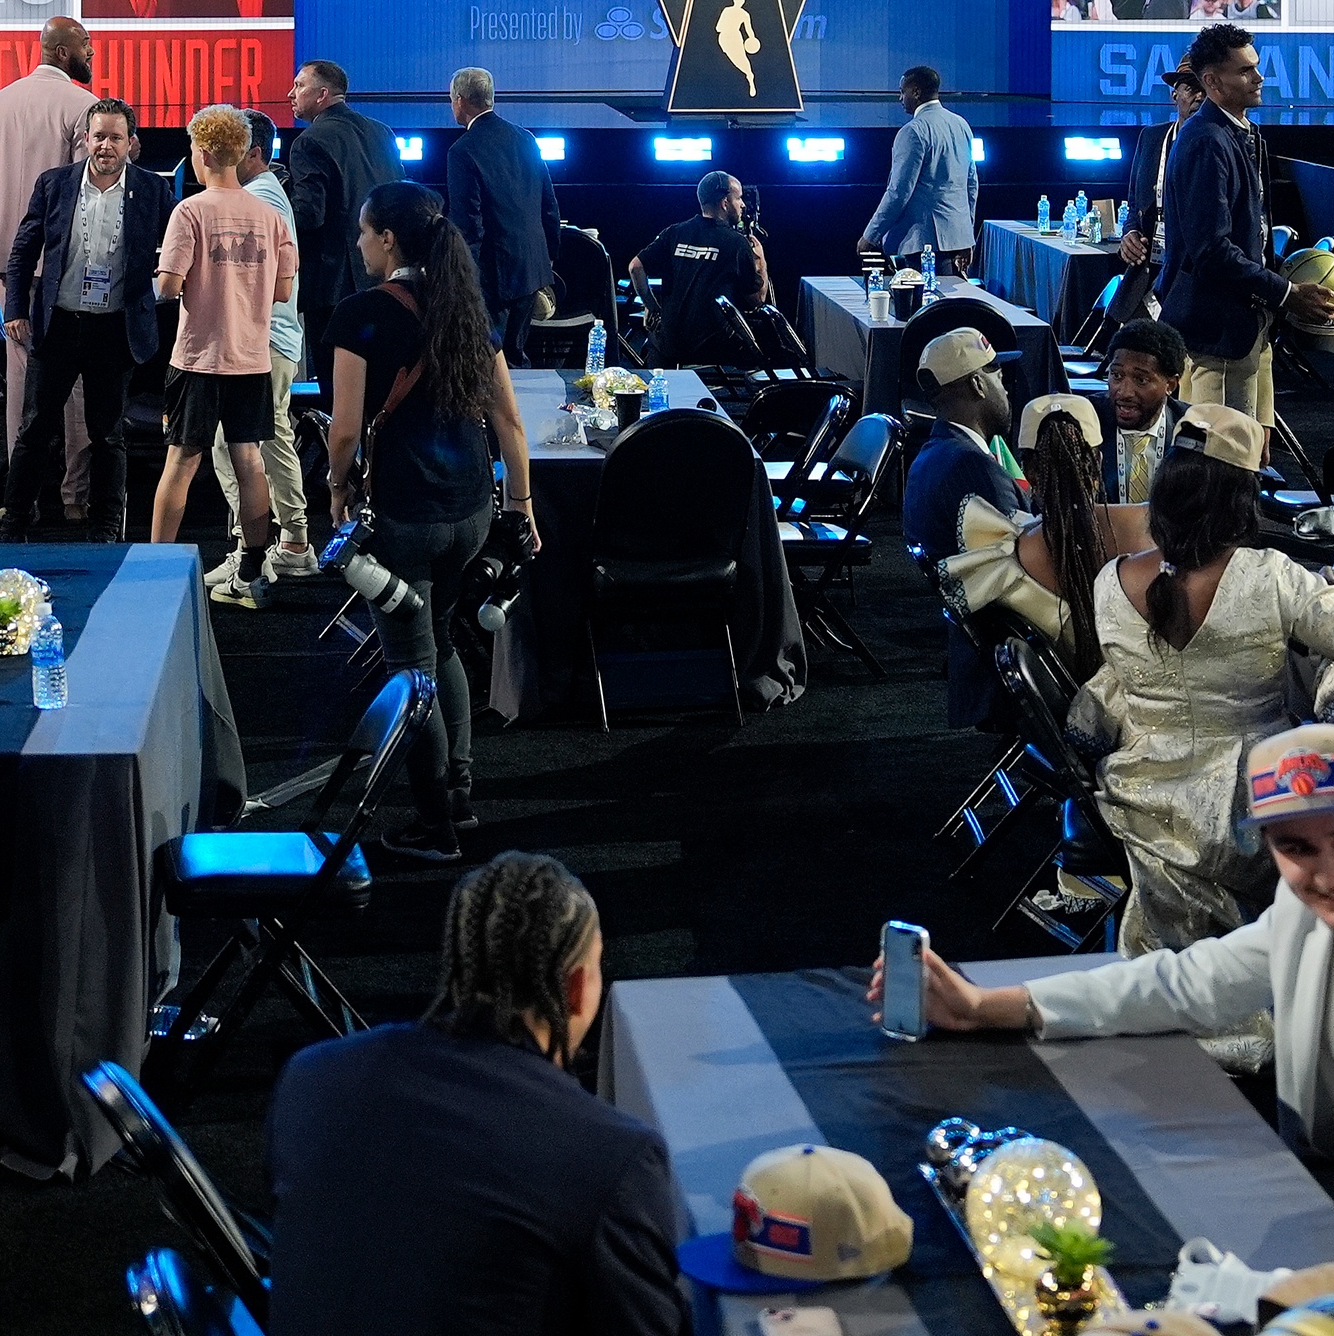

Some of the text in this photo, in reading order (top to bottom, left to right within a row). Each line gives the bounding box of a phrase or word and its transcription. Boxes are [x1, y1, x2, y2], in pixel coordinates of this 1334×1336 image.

[471, 6, 582, 44] Presented by
[674, 243, 719, 260] ESPN
